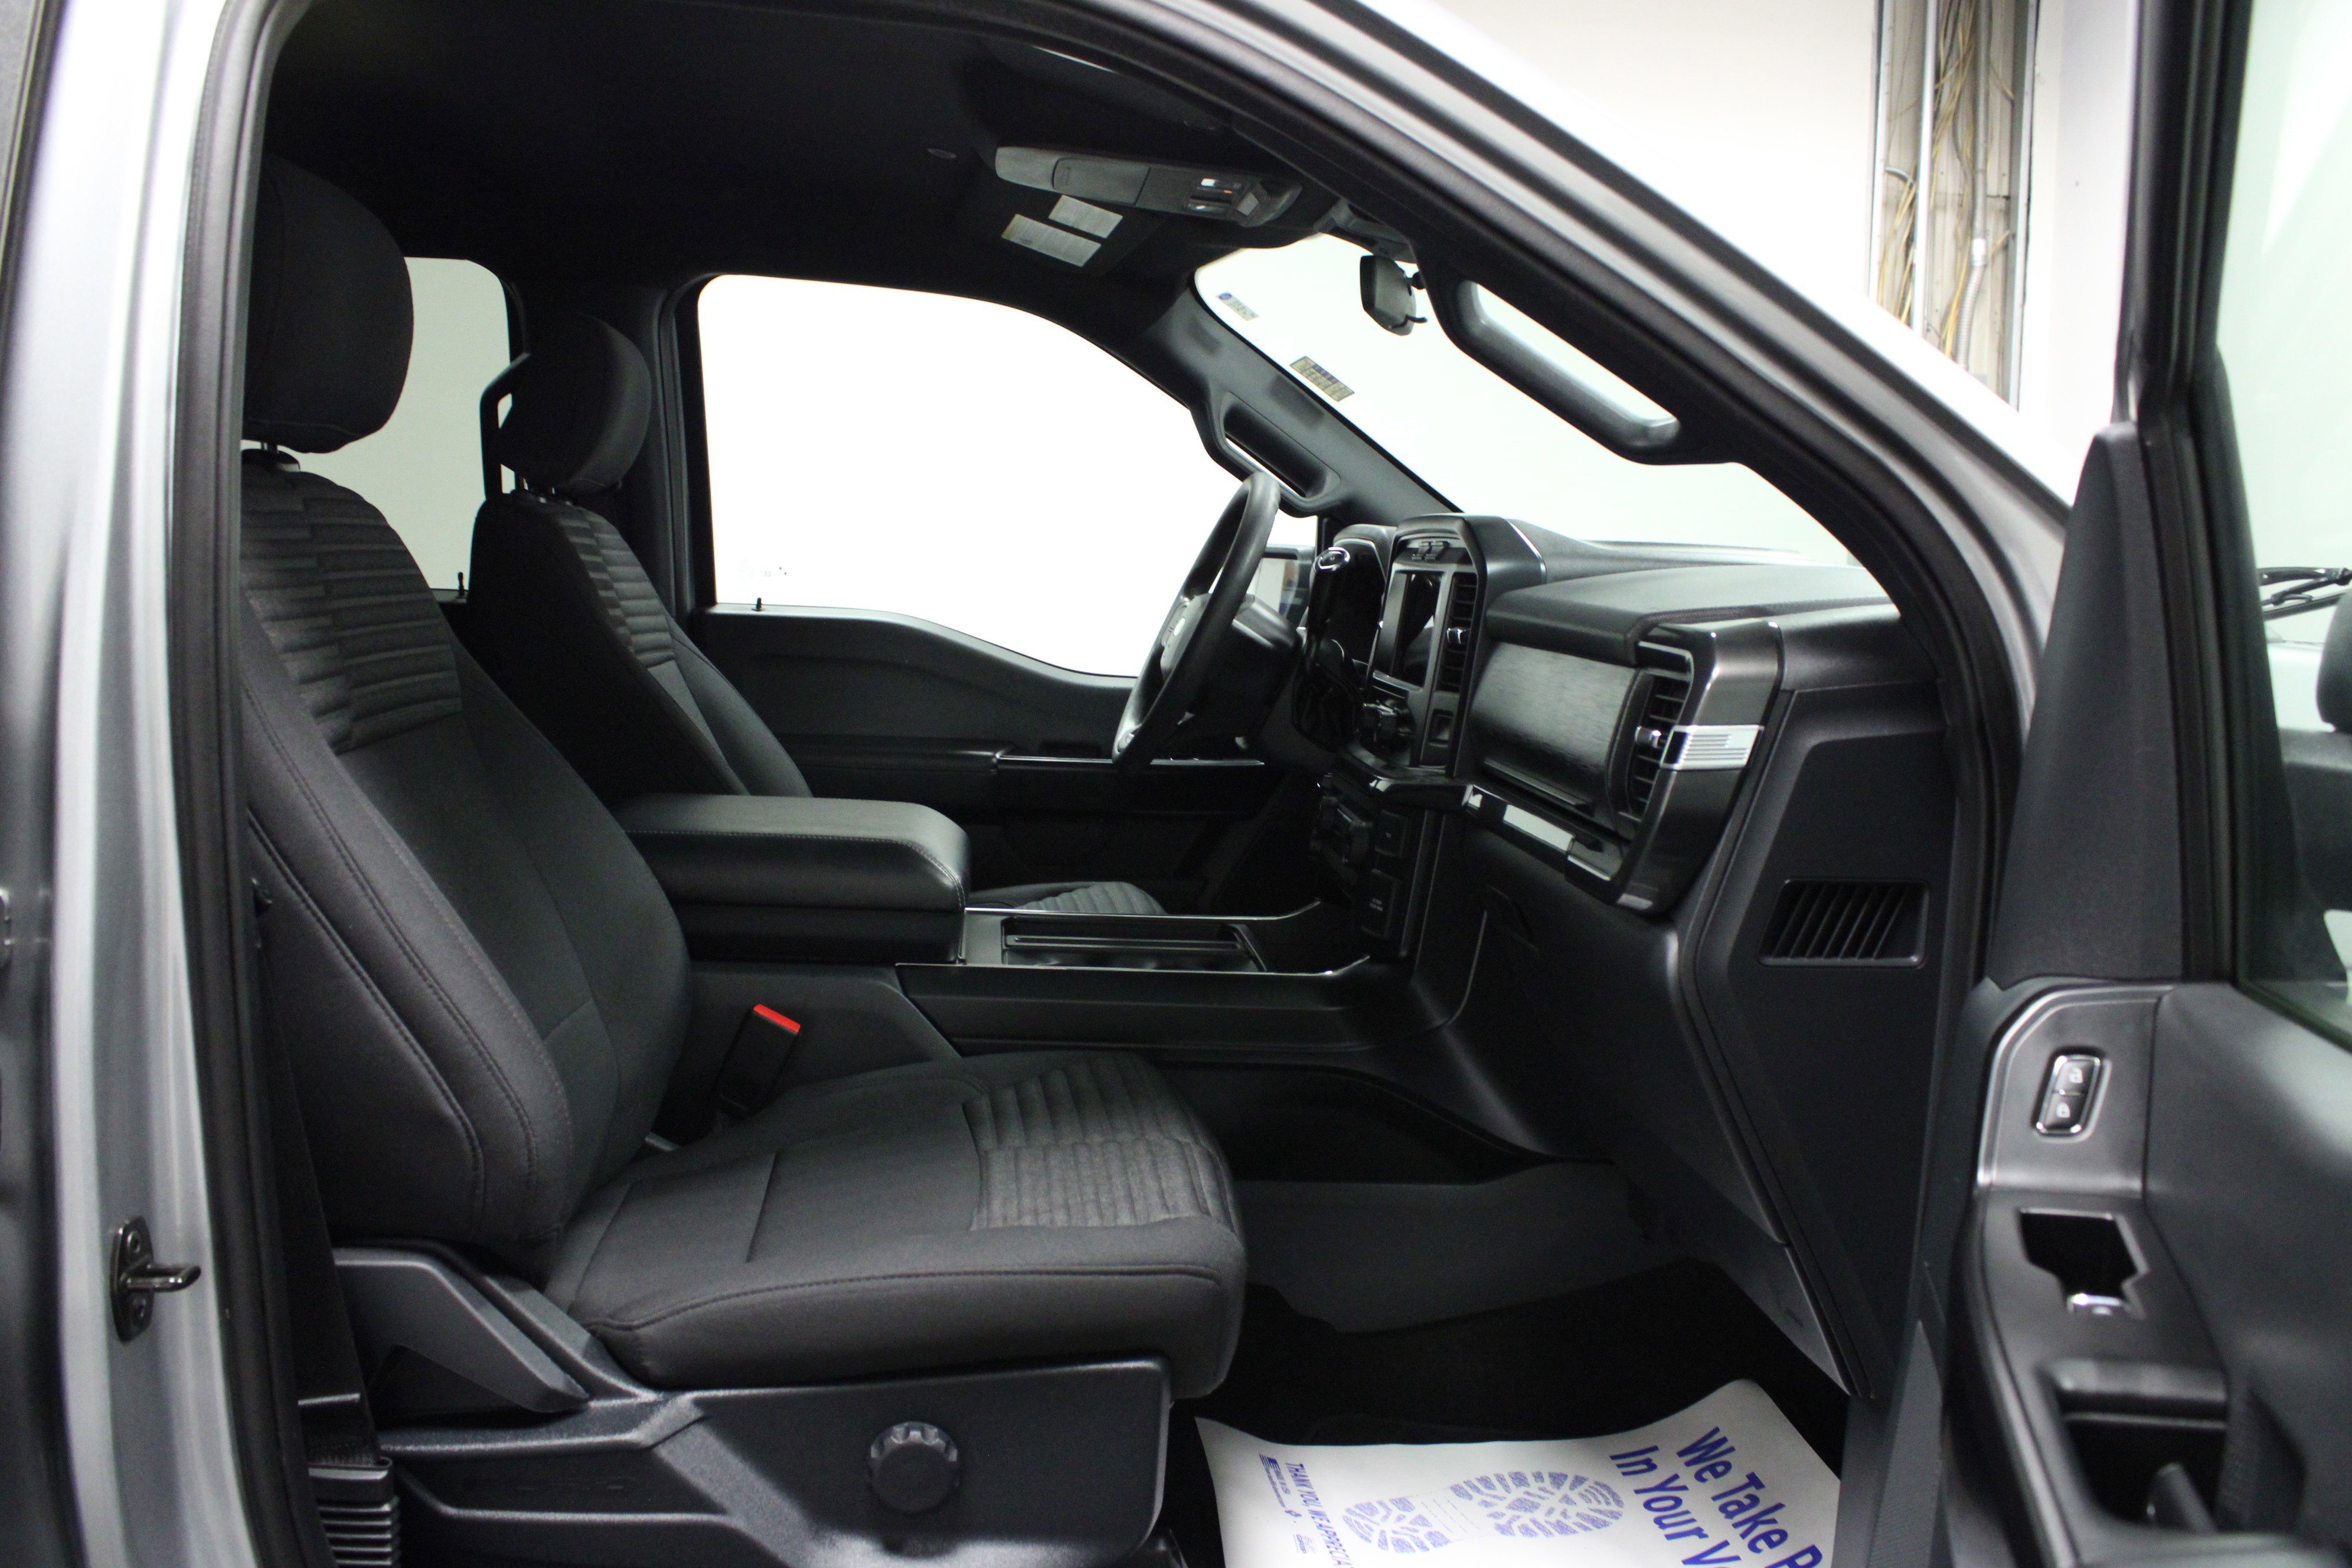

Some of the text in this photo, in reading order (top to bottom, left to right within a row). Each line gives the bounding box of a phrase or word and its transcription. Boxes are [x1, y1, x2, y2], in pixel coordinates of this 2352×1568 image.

[1285, 1462, 1314, 1490] THANK
[1676, 1426, 1736, 1484] We
[1711, 1471, 1789, 1554] Take
[1308, 1509, 1331, 1524] WE
[1609, 1445, 1742, 1568] In Your V
[1314, 1521, 1355, 1568] APPRECIA
